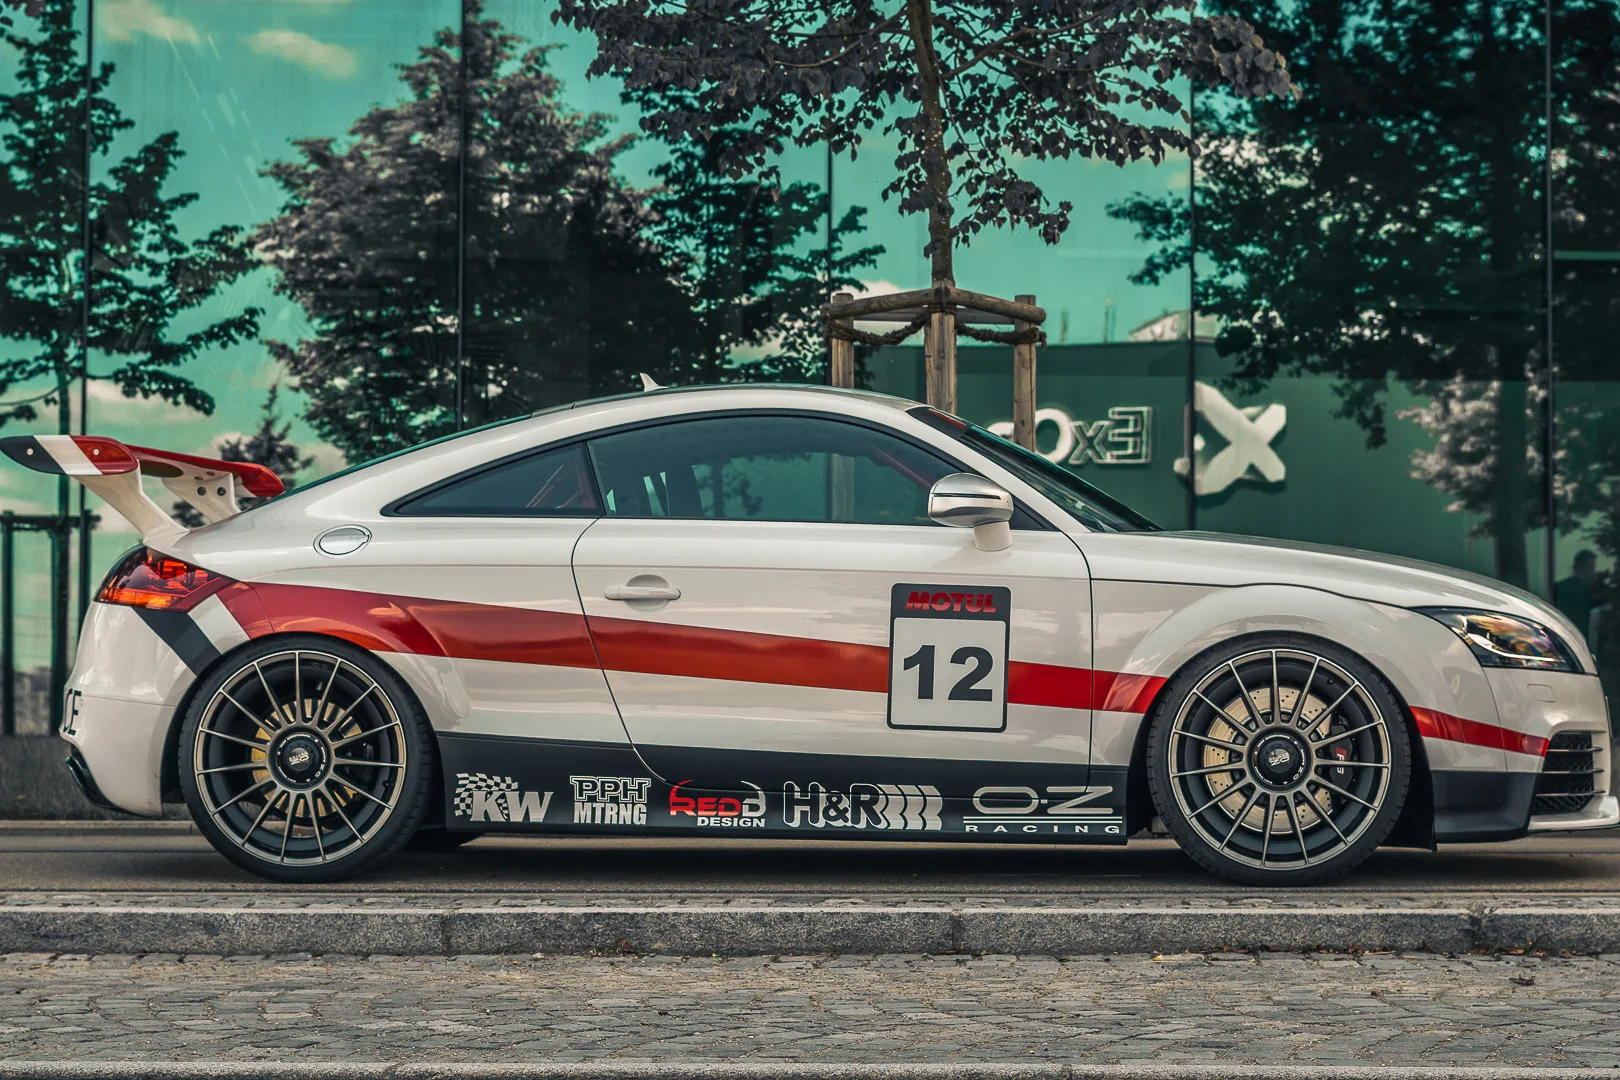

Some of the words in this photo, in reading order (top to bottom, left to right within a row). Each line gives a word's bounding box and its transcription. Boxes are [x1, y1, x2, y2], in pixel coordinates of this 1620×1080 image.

[905, 591, 997, 613] MOTUL
[903, 644, 994, 702] 12
[569, 775, 651, 803] PPH
[469, 790, 554, 823] KW
[573, 802, 648, 825] MTRNG
[783, 781, 889, 828] H&R
[696, 816, 766, 828] DESIGN
[965, 825, 1121, 834] RACING
